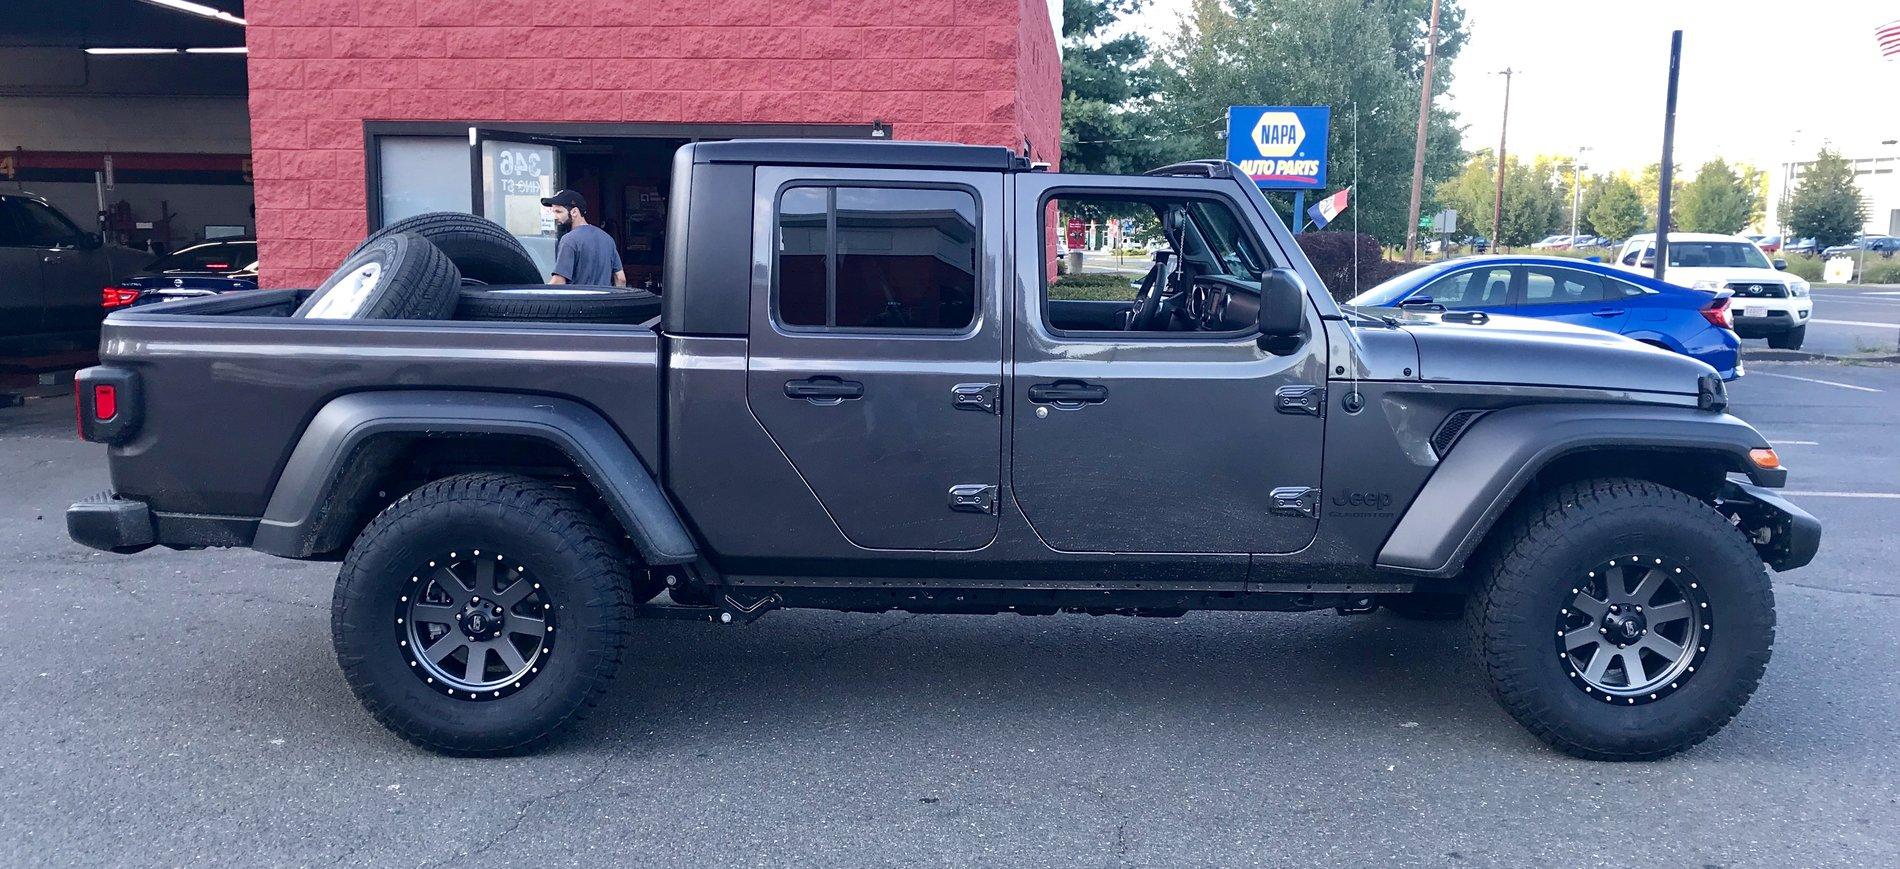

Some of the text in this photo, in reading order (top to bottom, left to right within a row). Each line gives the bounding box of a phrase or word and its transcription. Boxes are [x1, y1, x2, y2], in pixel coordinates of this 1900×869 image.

[1261, 125, 1297, 144] NAPA
[1240, 160, 1319, 175] AUTO PARTS
[1332, 487, 1391, 510] Jeep
